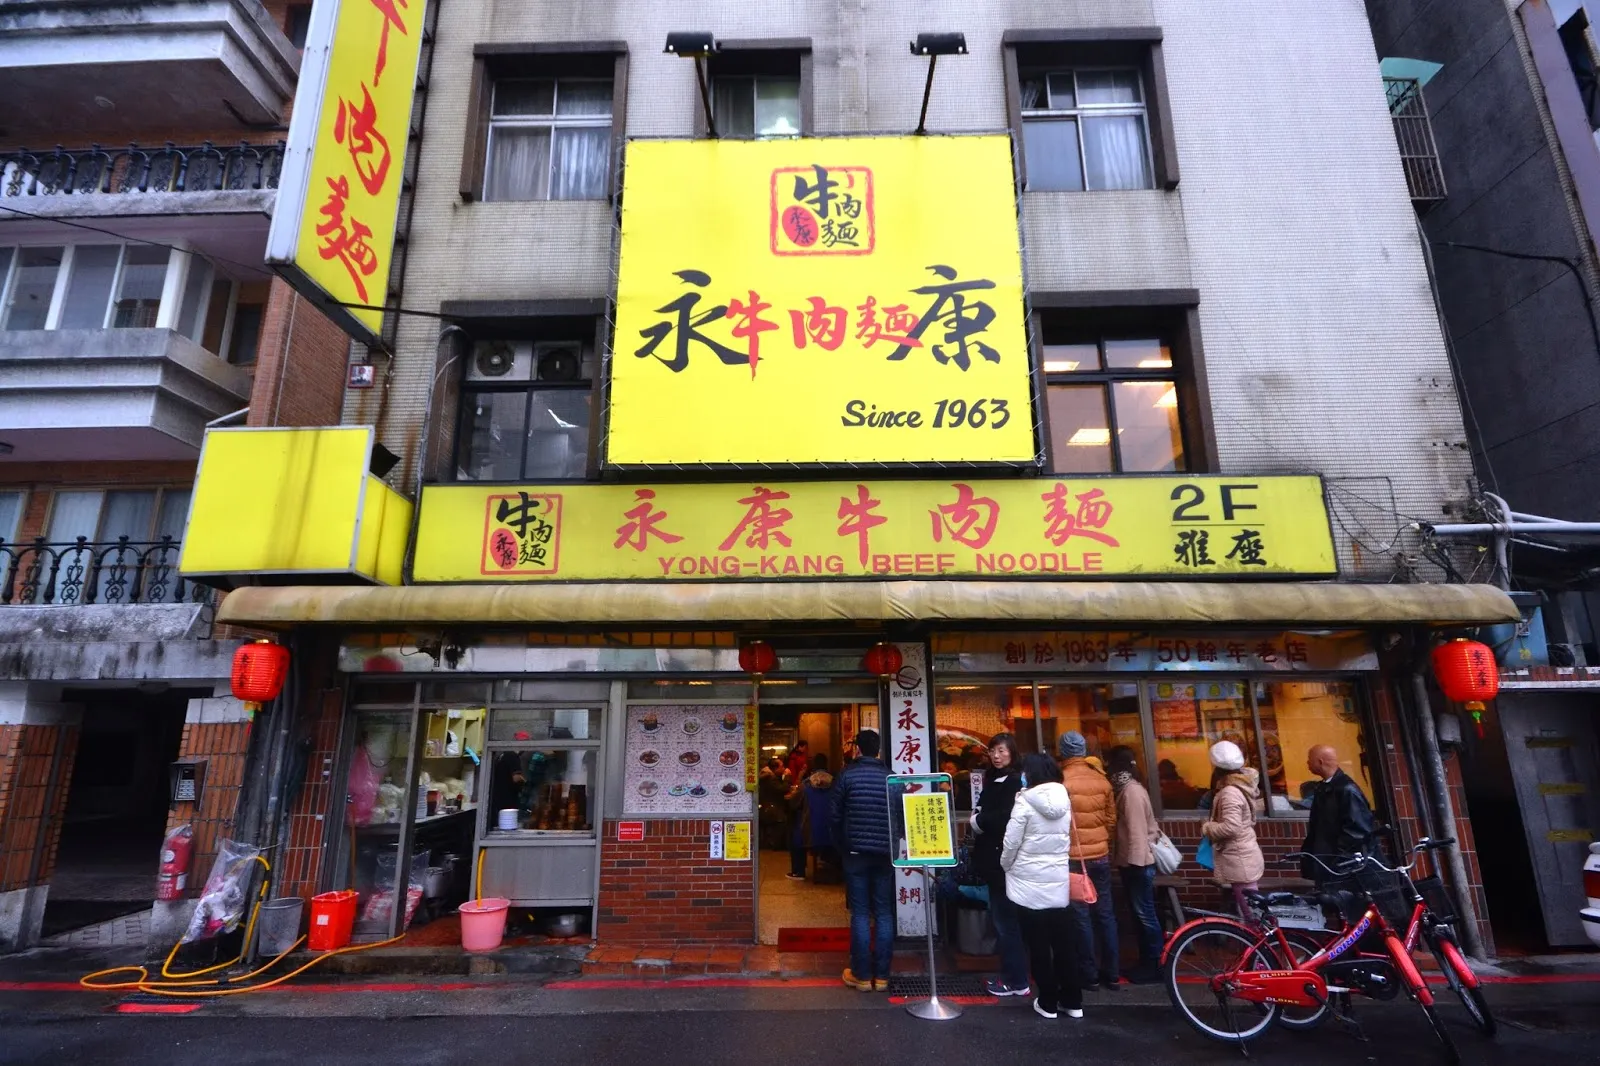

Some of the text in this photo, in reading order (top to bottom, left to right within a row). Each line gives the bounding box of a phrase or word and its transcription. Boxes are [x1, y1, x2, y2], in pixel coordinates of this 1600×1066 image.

[841, 398, 1010, 430] Since 1963
[1171, 484, 1259, 522] 2F
[614, 482, 1120, 569] 永康牛肉麵
[658, 552, 1103, 576] YONG-KANG BEEF NOODLE
[1173, 529, 1267, 567] 雅座
[1327, 916, 1371, 961] PATRIOT
